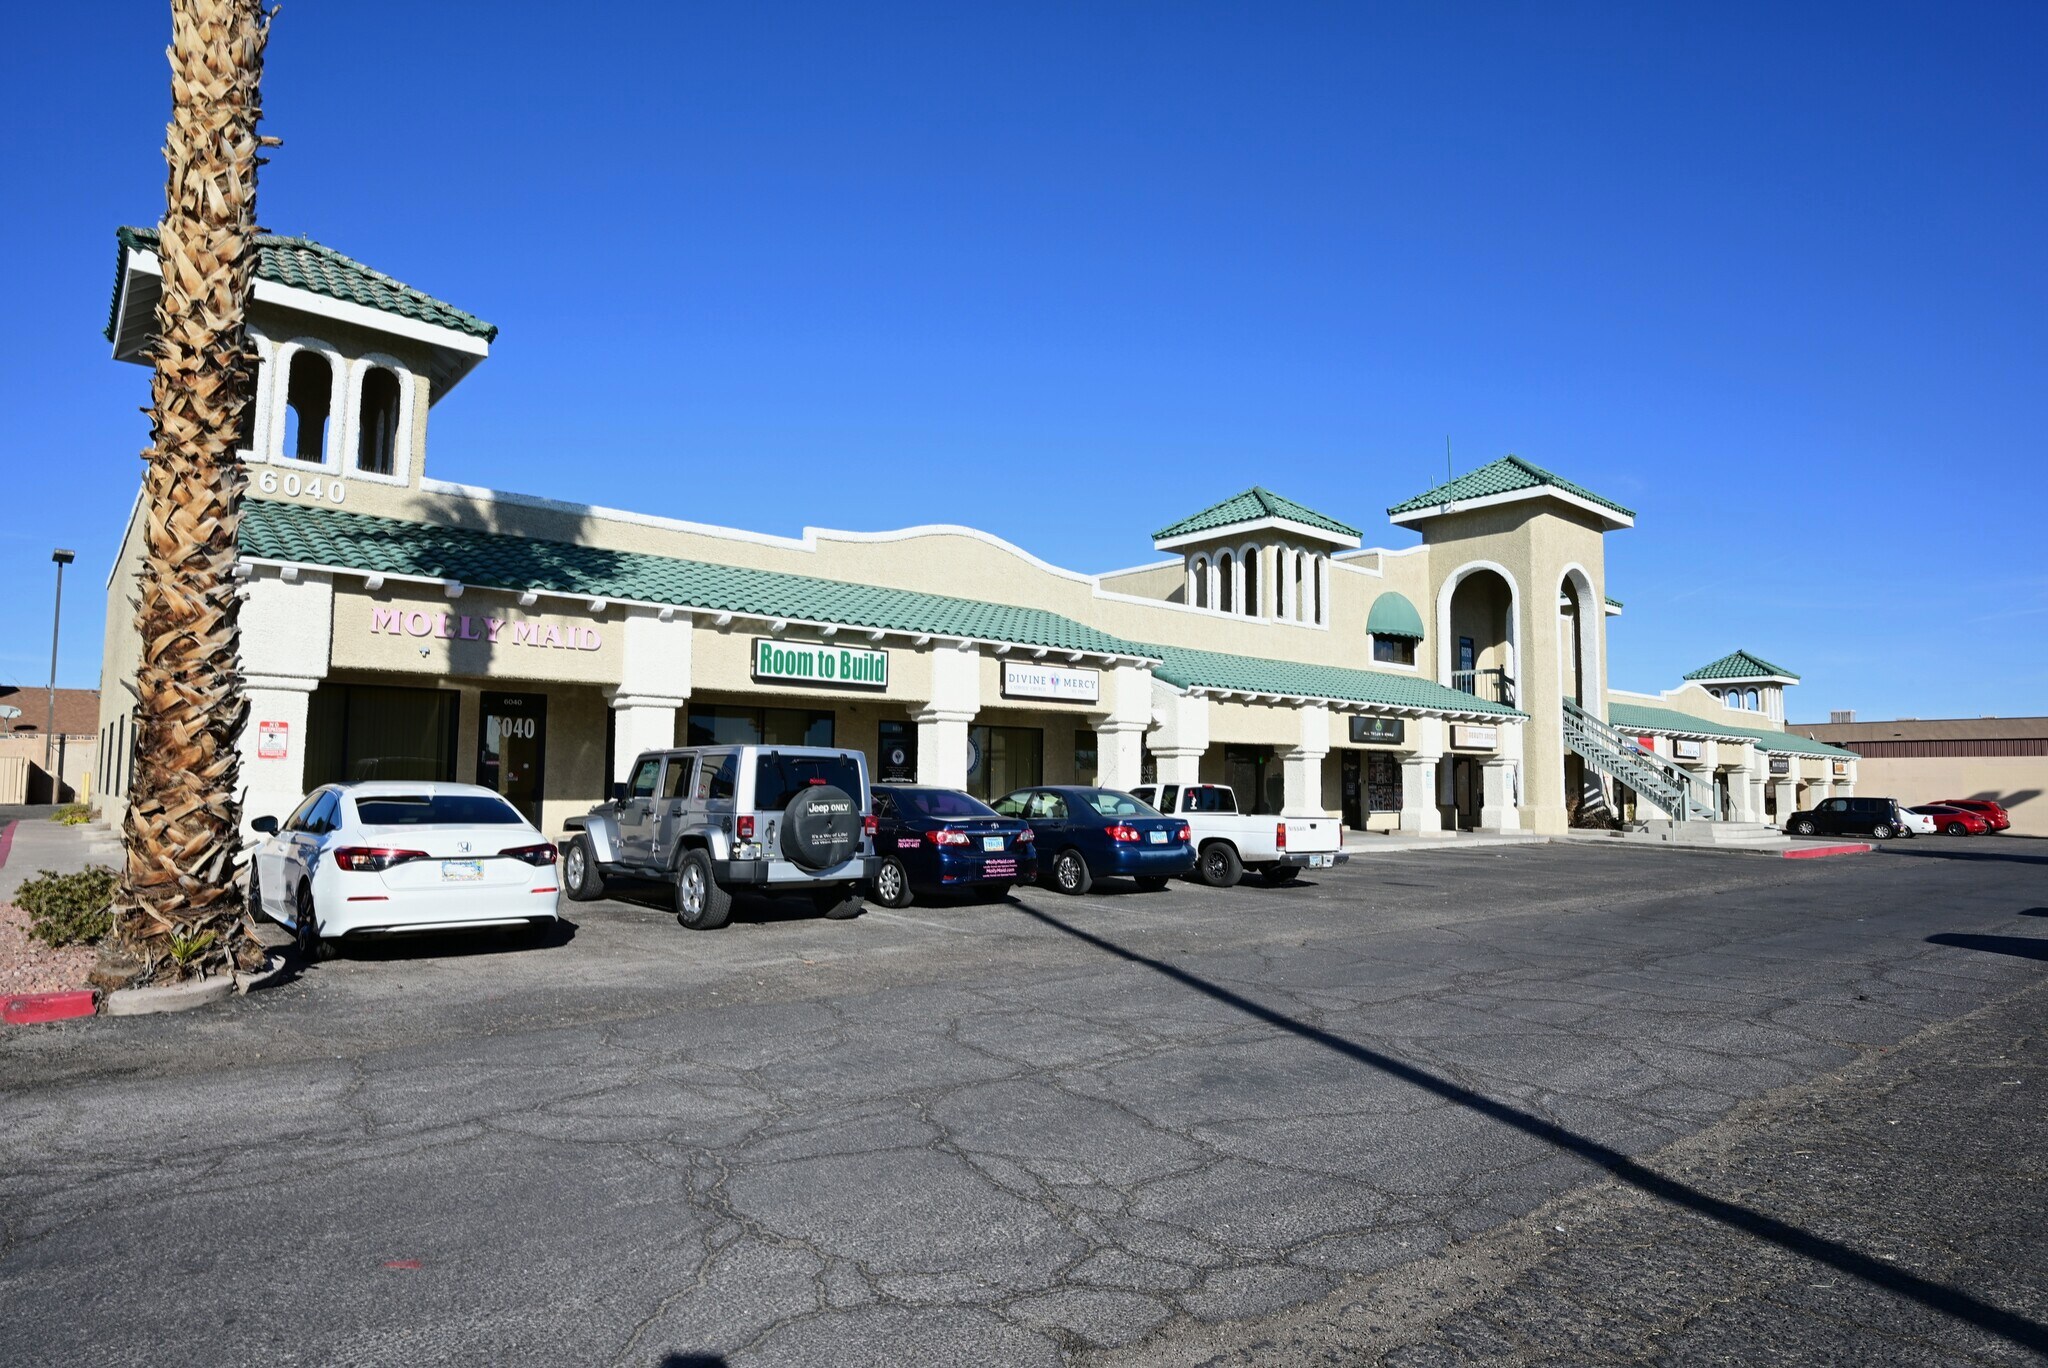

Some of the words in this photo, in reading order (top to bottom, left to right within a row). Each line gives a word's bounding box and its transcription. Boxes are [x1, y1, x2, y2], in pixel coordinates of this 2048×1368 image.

[259, 469, 346, 504] 6040
[370, 607, 507, 644] MOLLY
[512, 620, 602, 651] MAID
[760, 643, 813, 676] Room
[817, 650, 835, 679] to
[840, 650, 885, 682] Build
[1008, 673, 1046, 685] DIVINE
[1063, 678, 1096, 689] MERCY
[503, 698, 523, 706] 6040
[809, 803, 829, 814] Jeep
[830, 803, 849, 812] ONLY
